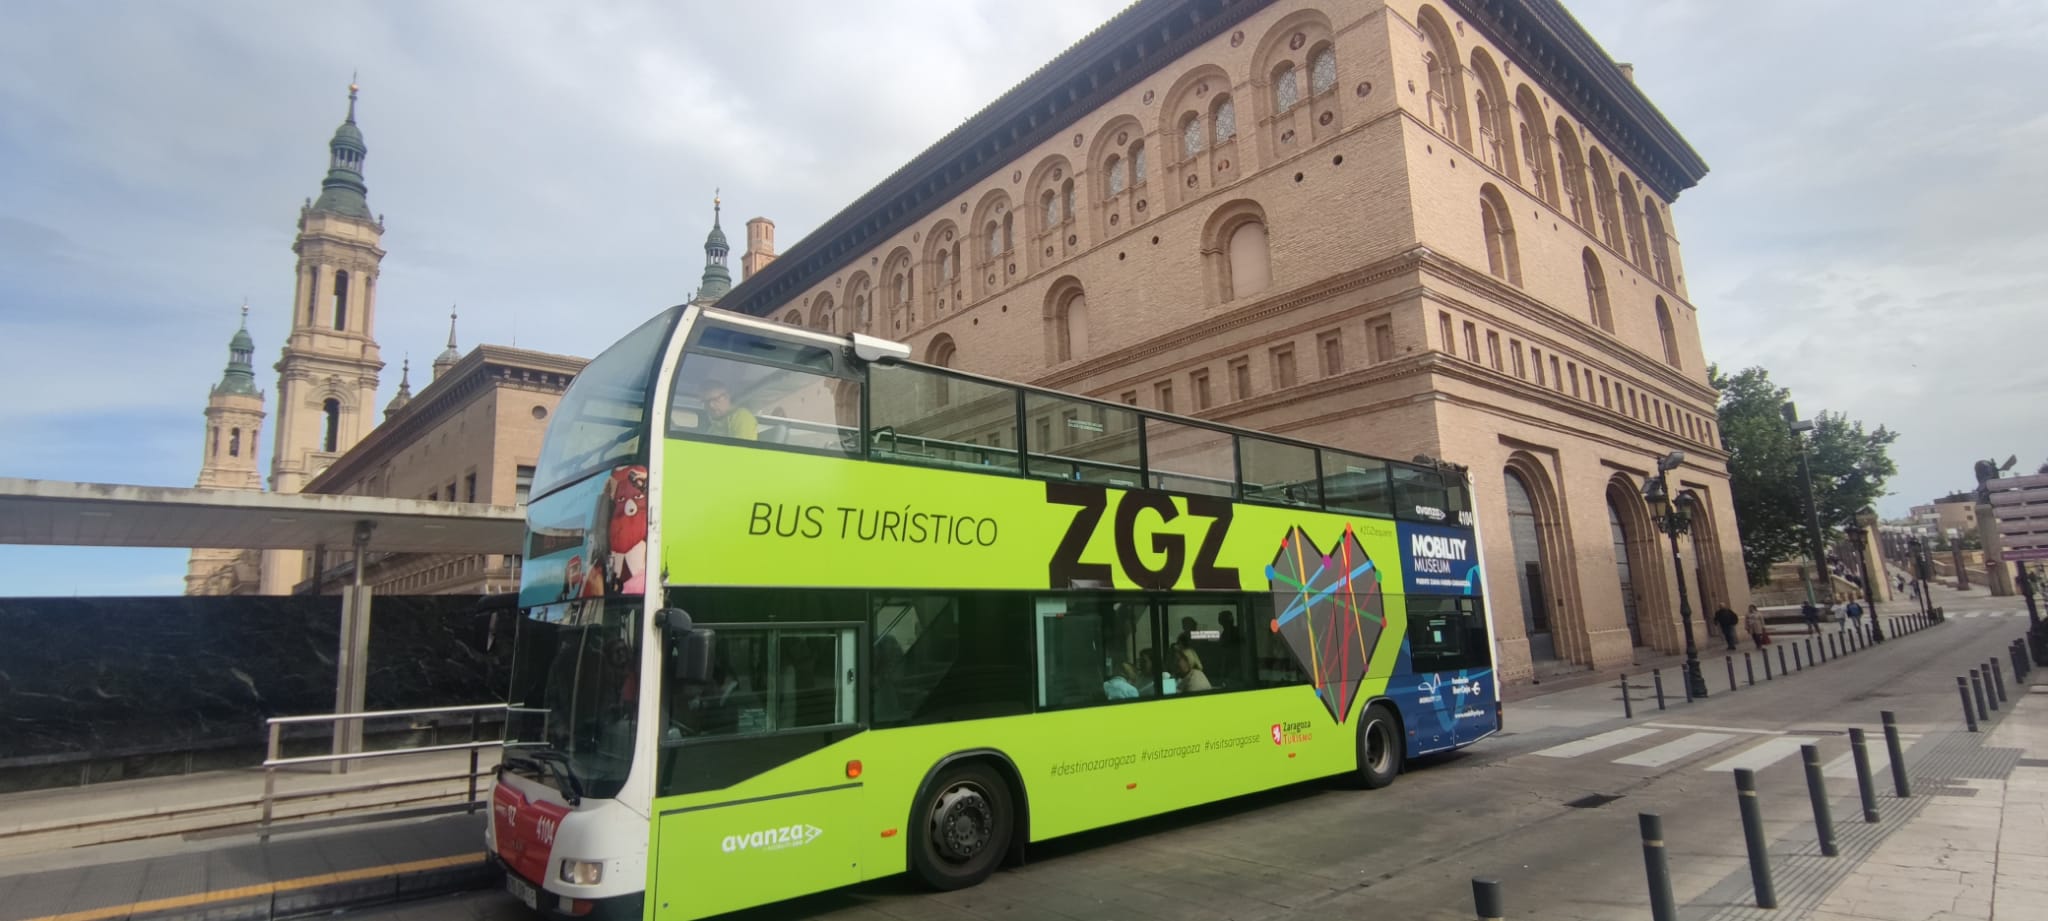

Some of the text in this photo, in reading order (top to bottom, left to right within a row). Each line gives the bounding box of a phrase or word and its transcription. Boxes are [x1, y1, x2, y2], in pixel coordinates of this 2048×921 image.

[748, 502, 998, 547] BUS TURÍSTICO
[1458, 510, 1473, 526] 4104
[1046, 482, 1243, 590] ZGZ
[1412, 533, 1467, 560] MOBILITY
[1414, 558, 1451, 574] MUSEUM
[1282, 720, 1312, 733] Zaragoza
[1051, 733, 1261, 776] #destinozaragoza #visitzaragoza #visitsaragosse
[536, 815, 556, 845] 4104
[722, 823, 804, 854] avanza
